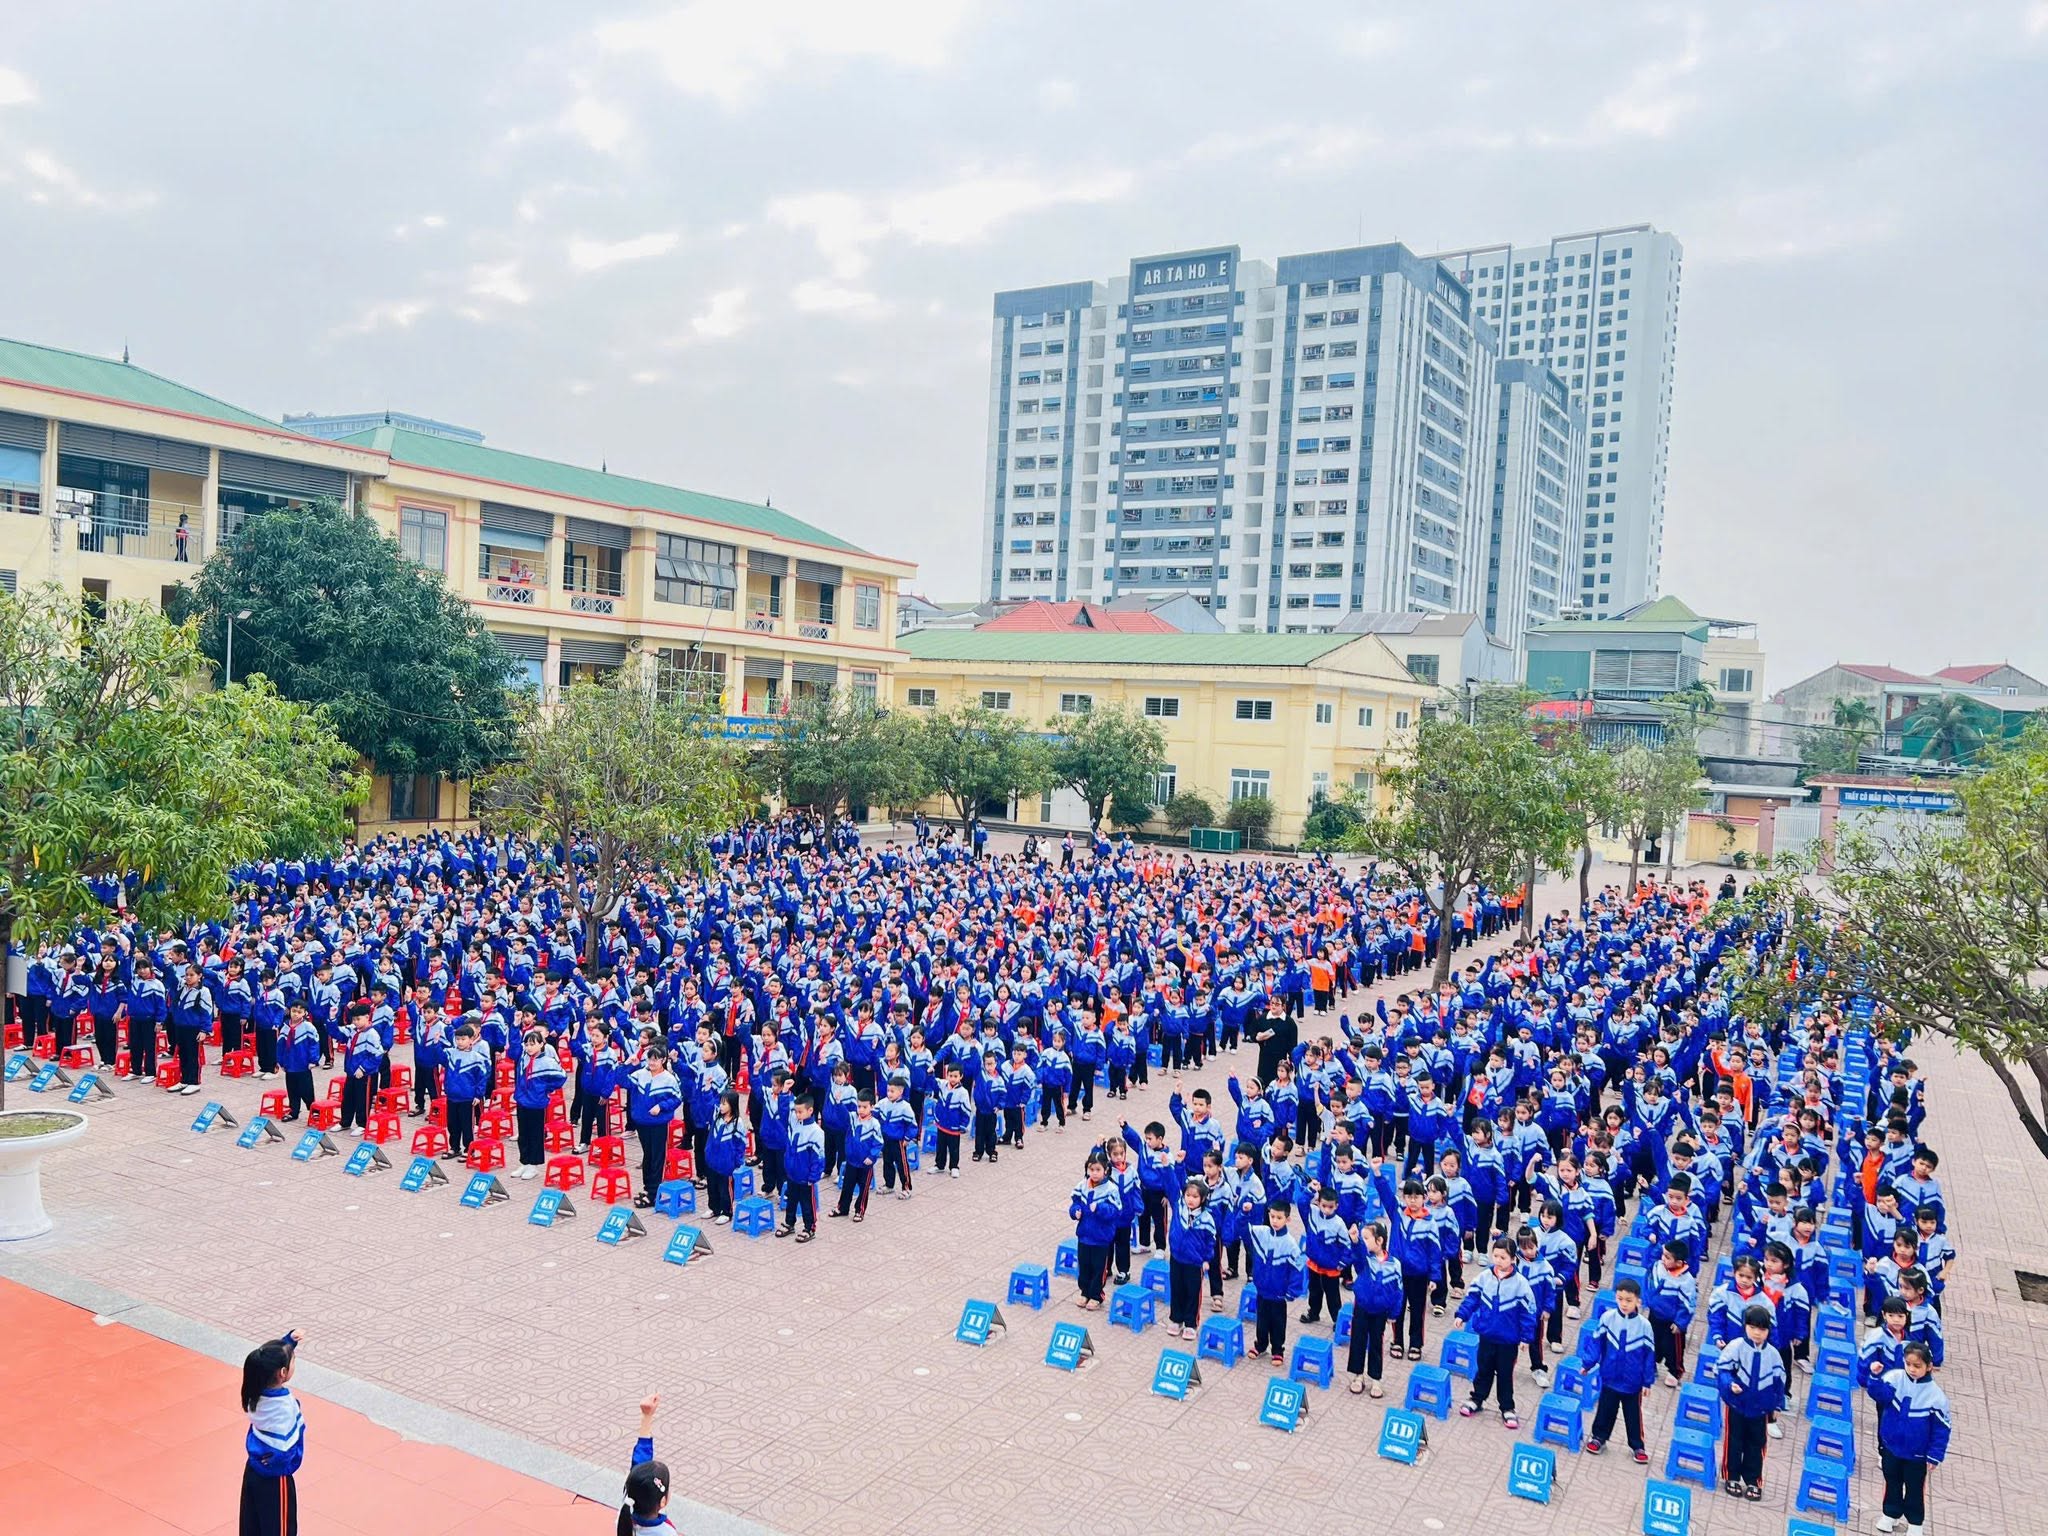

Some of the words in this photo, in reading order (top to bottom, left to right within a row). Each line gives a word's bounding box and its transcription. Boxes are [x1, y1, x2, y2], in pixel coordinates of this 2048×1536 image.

[357, 1149, 370, 1159] 4D
[412, 1164, 425, 1176] 4C
[540, 1198, 554, 1210] 4A
[610, 1215, 625, 1228] 1M
[675, 1233, 691, 1245] 1K
[1057, 1334, 1075, 1350] 1H
[1165, 1361, 1185, 1378] 1G
[1273, 1391, 1293, 1409] 1E
[1390, 1421, 1413, 1439] 1D
[1520, 1458, 1543, 1477] 1C
[1653, 1497, 1680, 1517] 1B
